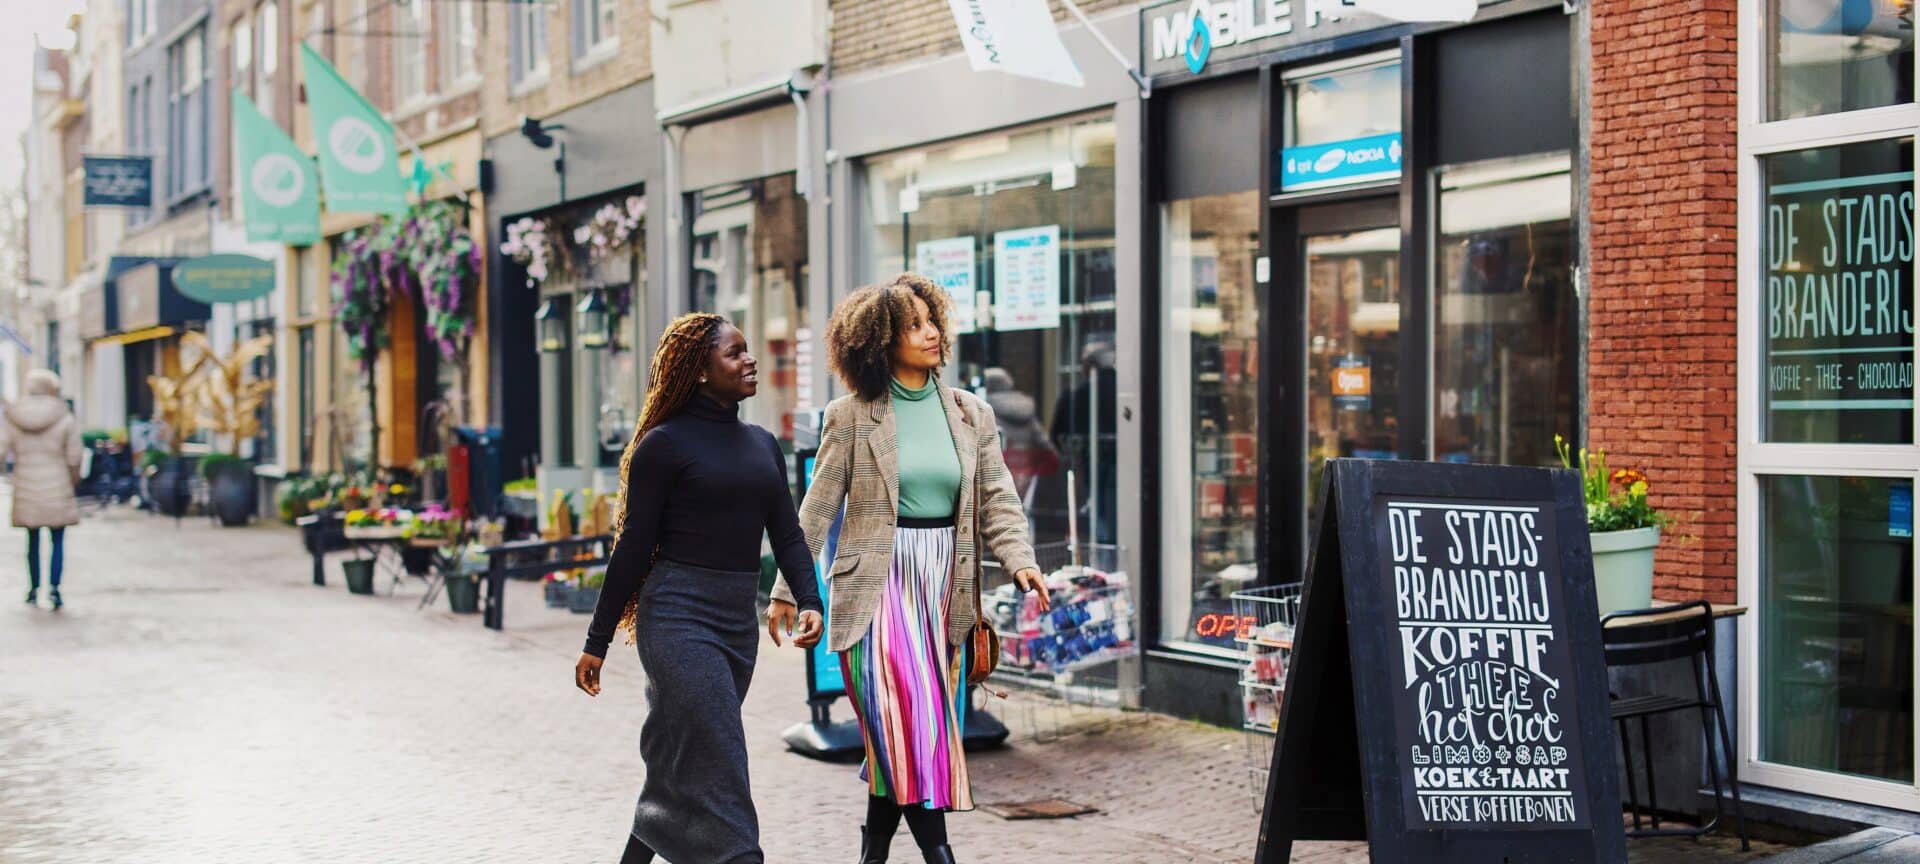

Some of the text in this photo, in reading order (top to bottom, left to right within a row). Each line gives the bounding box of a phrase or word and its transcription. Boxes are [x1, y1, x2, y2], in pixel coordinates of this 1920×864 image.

[1152, 0, 1293, 74] MOBILE
[1769, 204, 1801, 271] DE
[1769, 364, 1801, 392] KOFFIE
[1816, 363, 1843, 390] THEE
[1388, 508, 1543, 568] DE STADS-
[1394, 566, 1549, 622] BRANDERIJ
[1399, 627, 1560, 689] KOFFIE
[1436, 661, 1533, 710] THEE
[1418, 681, 1563, 750] hot choc
[1417, 796, 1471, 822] VERSE
